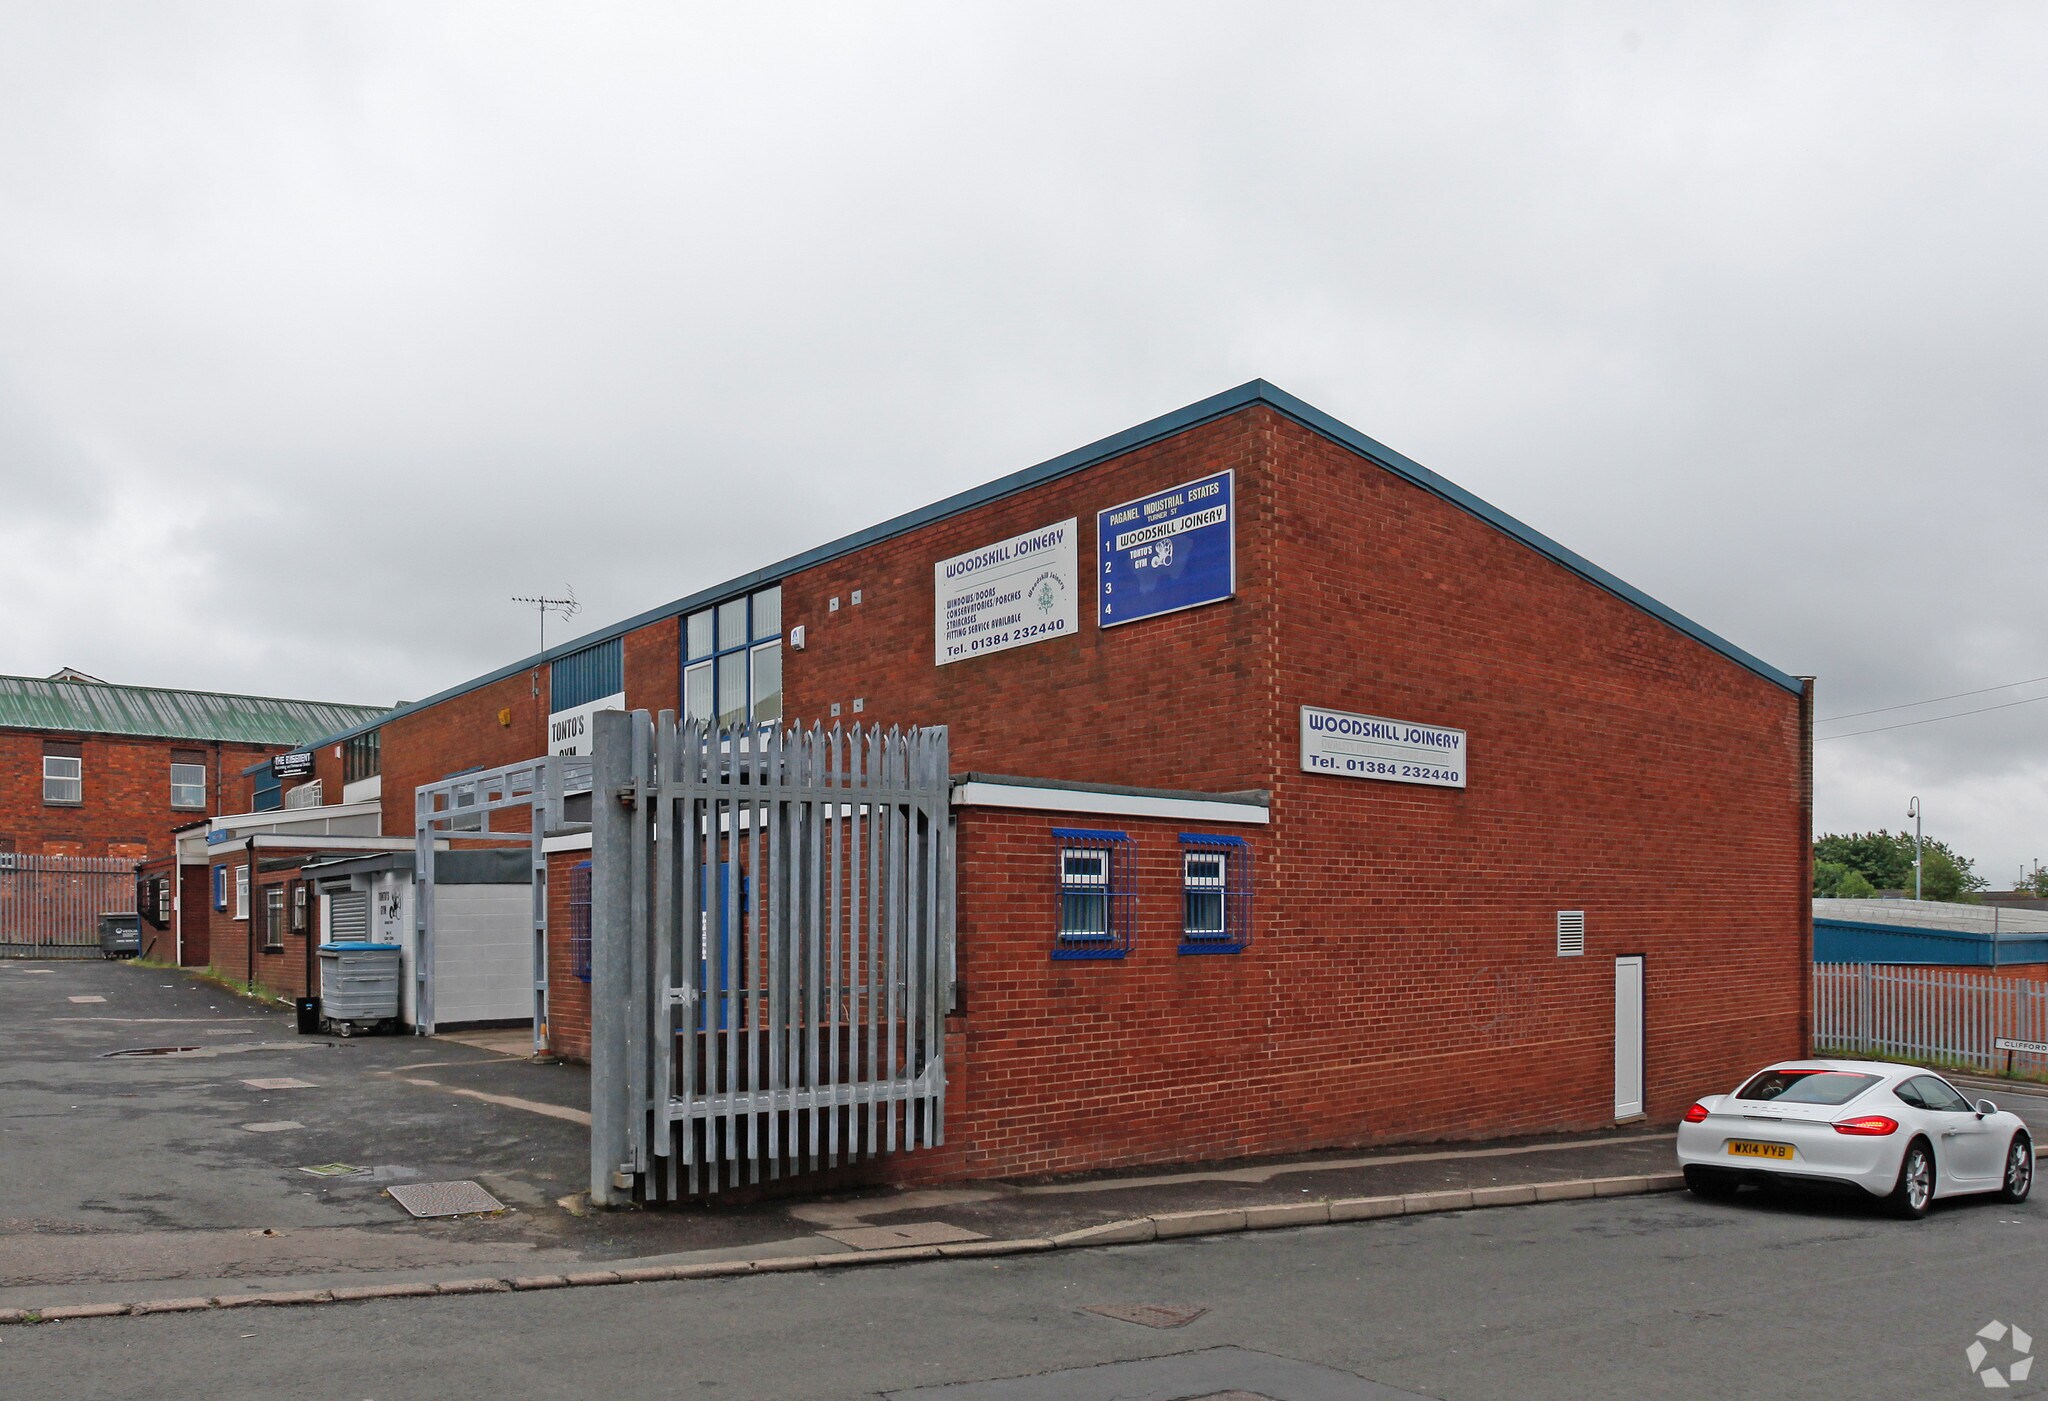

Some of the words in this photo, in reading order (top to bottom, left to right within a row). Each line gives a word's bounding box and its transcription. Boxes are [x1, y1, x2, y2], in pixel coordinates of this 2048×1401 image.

[1110, 507, 1139, 526] PAGANEL
[1144, 493, 1184, 516] INDUSTRIAL
[1188, 482, 1219, 502] ESTATES
[1147, 511, 1167, 523] TURNER
[1170, 507, 1177, 516] ST
[1105, 541, 1110, 552] 1
[1120, 521, 1176, 547] WOODSKILL
[1180, 507, 1222, 531] JOINERY
[946, 550, 1010, 579] WOODSKILL
[1013, 529, 1064, 557] JOINERY
[1105, 562, 1112, 573] 2
[1105, 583, 1112, 594] 3
[946, 614, 977, 630] STAIRCASES
[1105, 603, 1112, 615] 4
[946, 627, 967, 640] FITTING
[968, 621, 990, 635] SERVICE
[991, 613, 1021, 629] AVAILABLE
[947, 643, 967, 656] Tel.
[971, 632, 1009, 651] 01384
[1013, 619, 1065, 640] 232440
[552, 714, 584, 743] TONTO'S
[1309, 714, 1399, 741] WOODSKILL
[1403, 728, 1459, 749] JOINERY
[1309, 754, 1340, 769] Tel.
[1346, 759, 1397, 775] 01384
[1402, 765, 1459, 782] 232440
[2004, 1041, 2047, 1051] CLIFFORD
[1763, 1145, 1786, 1157] VYB
